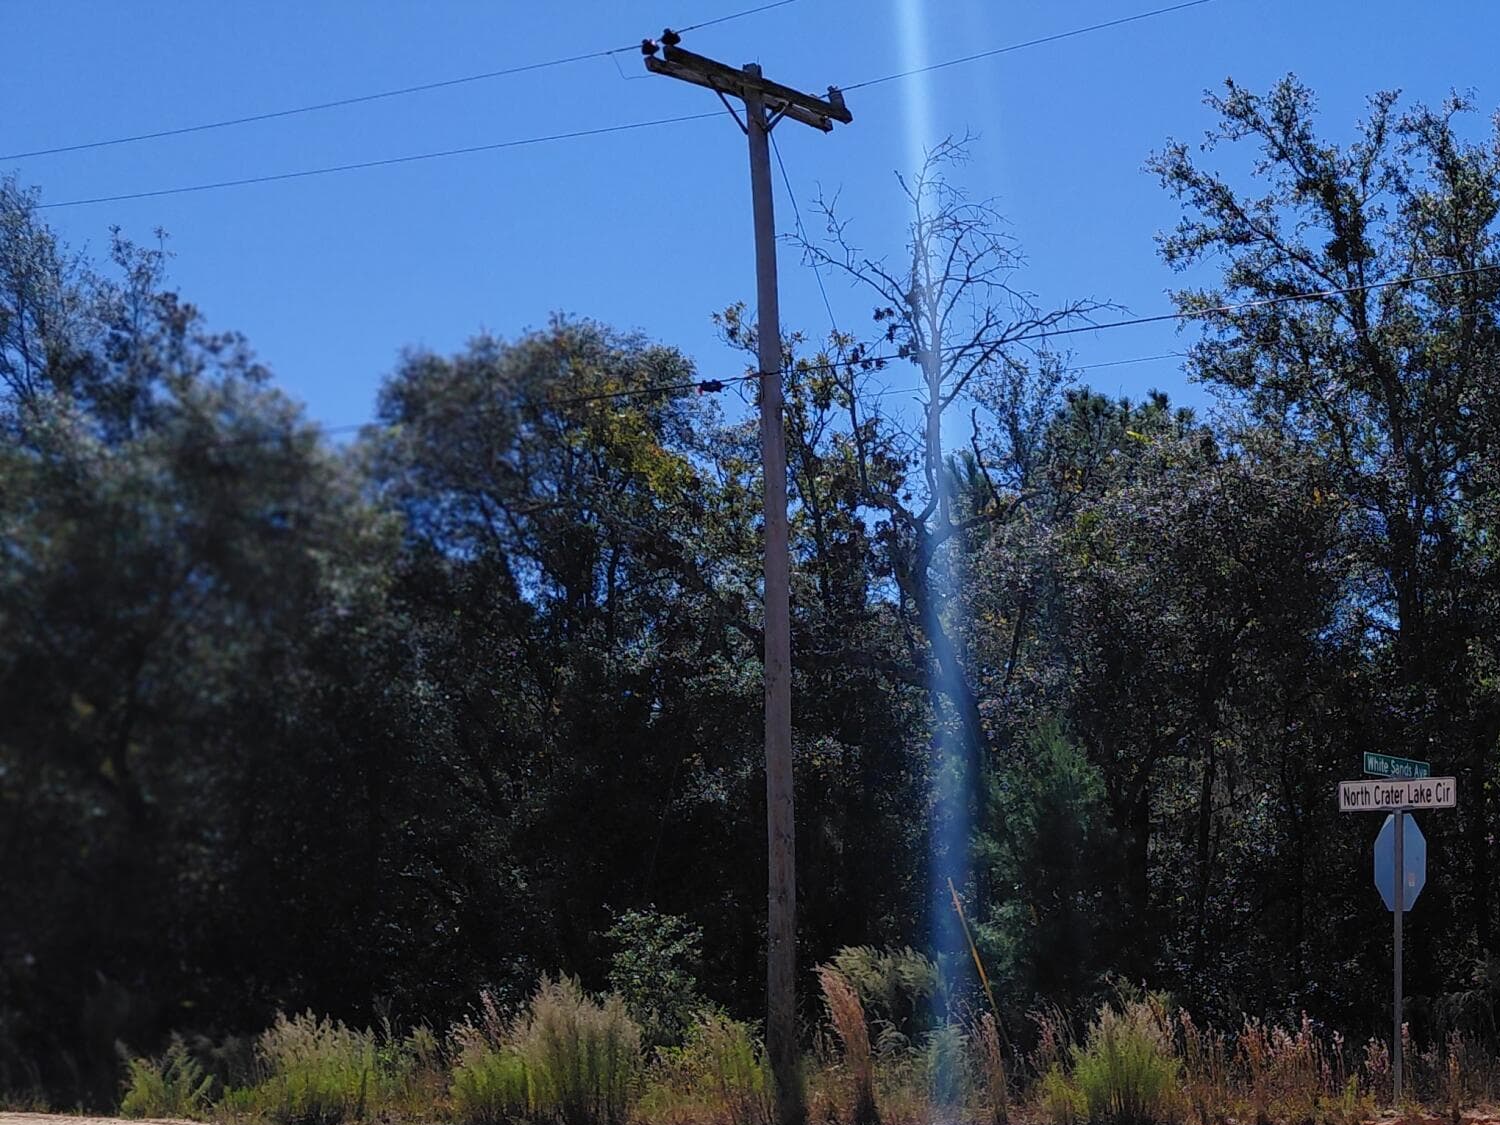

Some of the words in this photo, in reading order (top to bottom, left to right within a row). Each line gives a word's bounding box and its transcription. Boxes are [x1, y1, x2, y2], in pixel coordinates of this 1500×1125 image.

[1367, 755, 1389, 773] White
[1390, 759, 1412, 777] Sands
[1414, 764, 1428, 778] Ave
[1343, 786, 1371, 807] North
[1374, 785, 1404, 806] Crater
[1407, 783, 1432, 804] Lake
[1435, 782, 1451, 803] Cir
